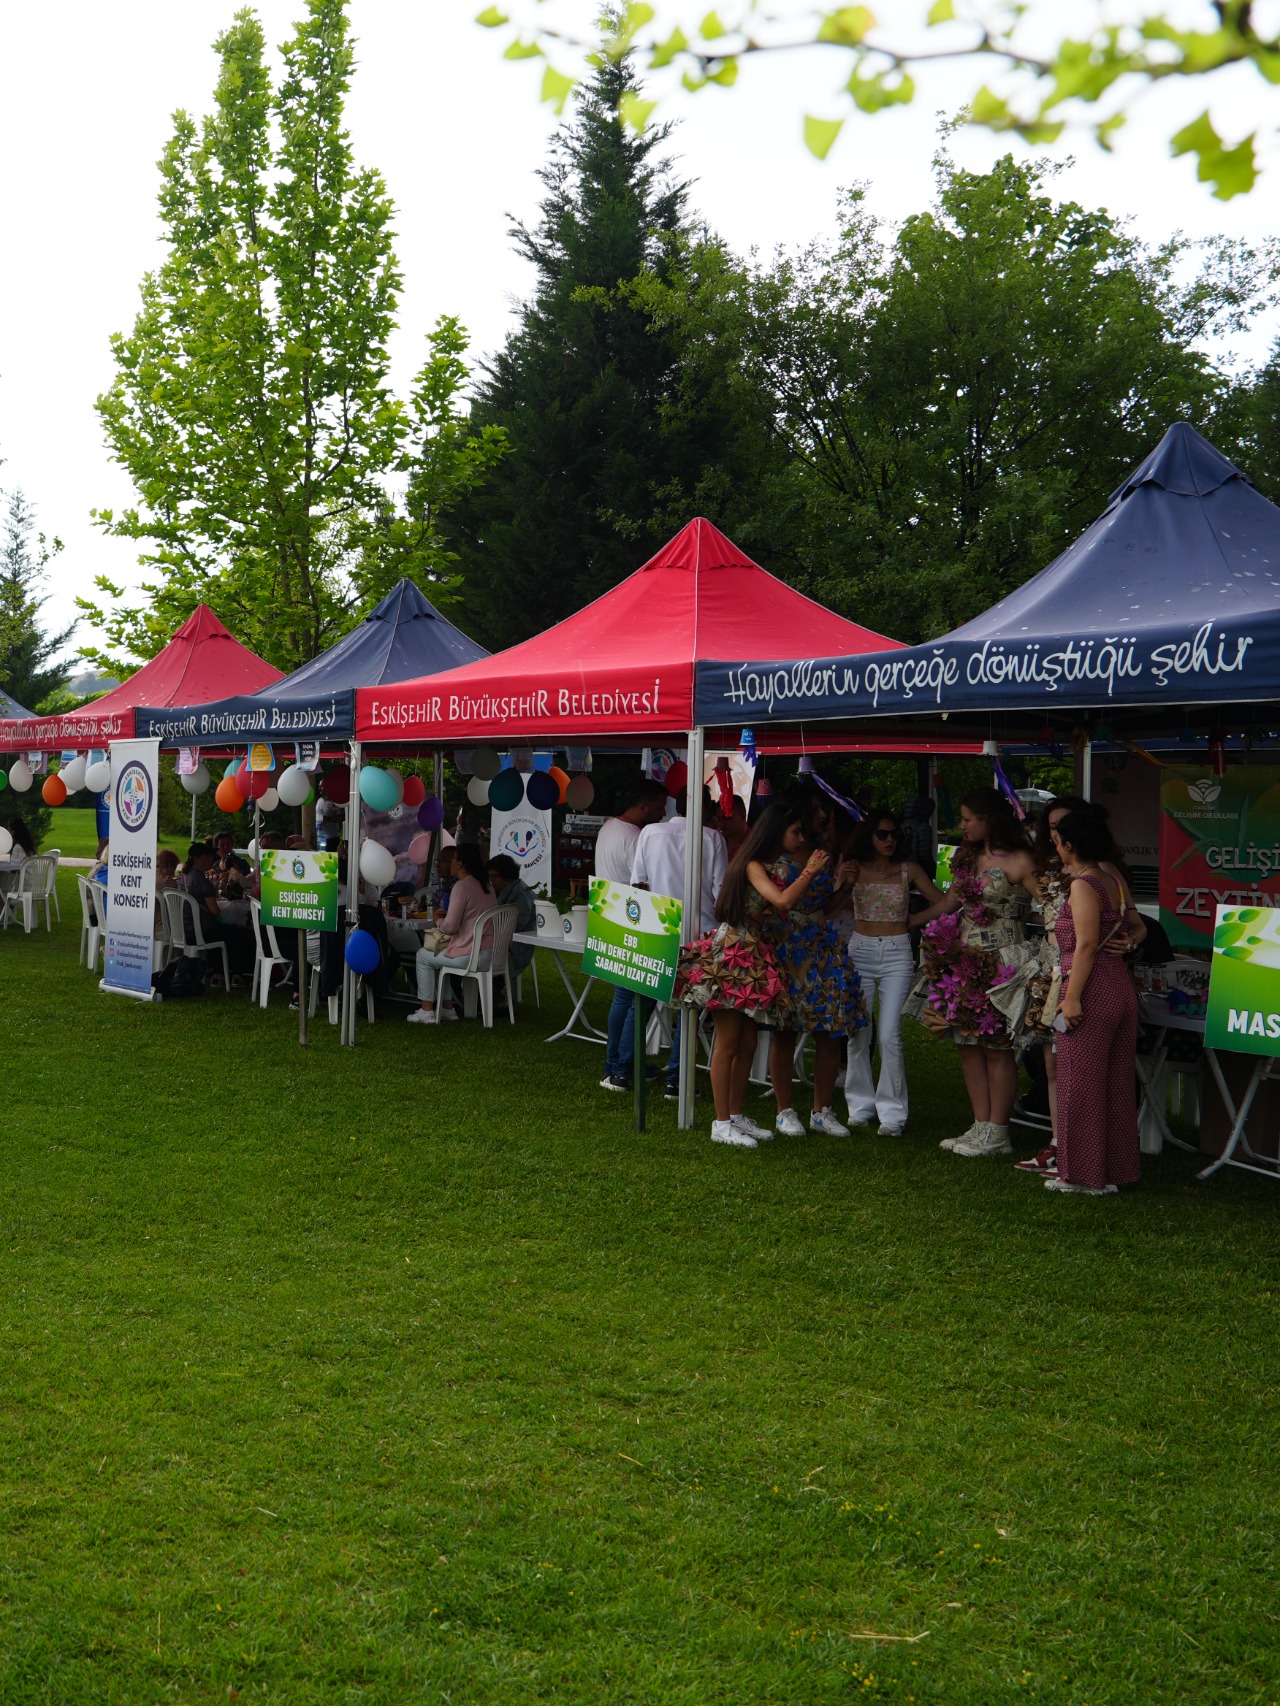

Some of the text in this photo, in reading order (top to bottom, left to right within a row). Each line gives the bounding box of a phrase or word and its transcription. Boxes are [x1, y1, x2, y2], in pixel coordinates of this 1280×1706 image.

[723, 621, 1254, 714] Hayallerin gerçeğe dönüştüğü şehir
[35, 719, 58, 746] gerçeğe
[100, 712, 122, 740] şehir
[113, 852, 152, 871] ESKİŞEHİR
[121, 875, 142, 889] KENT
[113, 893, 149, 909] KONSEYİ
[279, 889, 319, 906] ESKİŞEHİR
[272, 906, 325, 922] KENT KONSEYİ
[623, 934, 638, 948] EBB
[587, 935, 673, 977] BİLİM DENEY MERKEZİ VE
[595, 955, 660, 988] SABANCI UZAY EVİ
[1227, 1009, 1280, 1038] MAS
